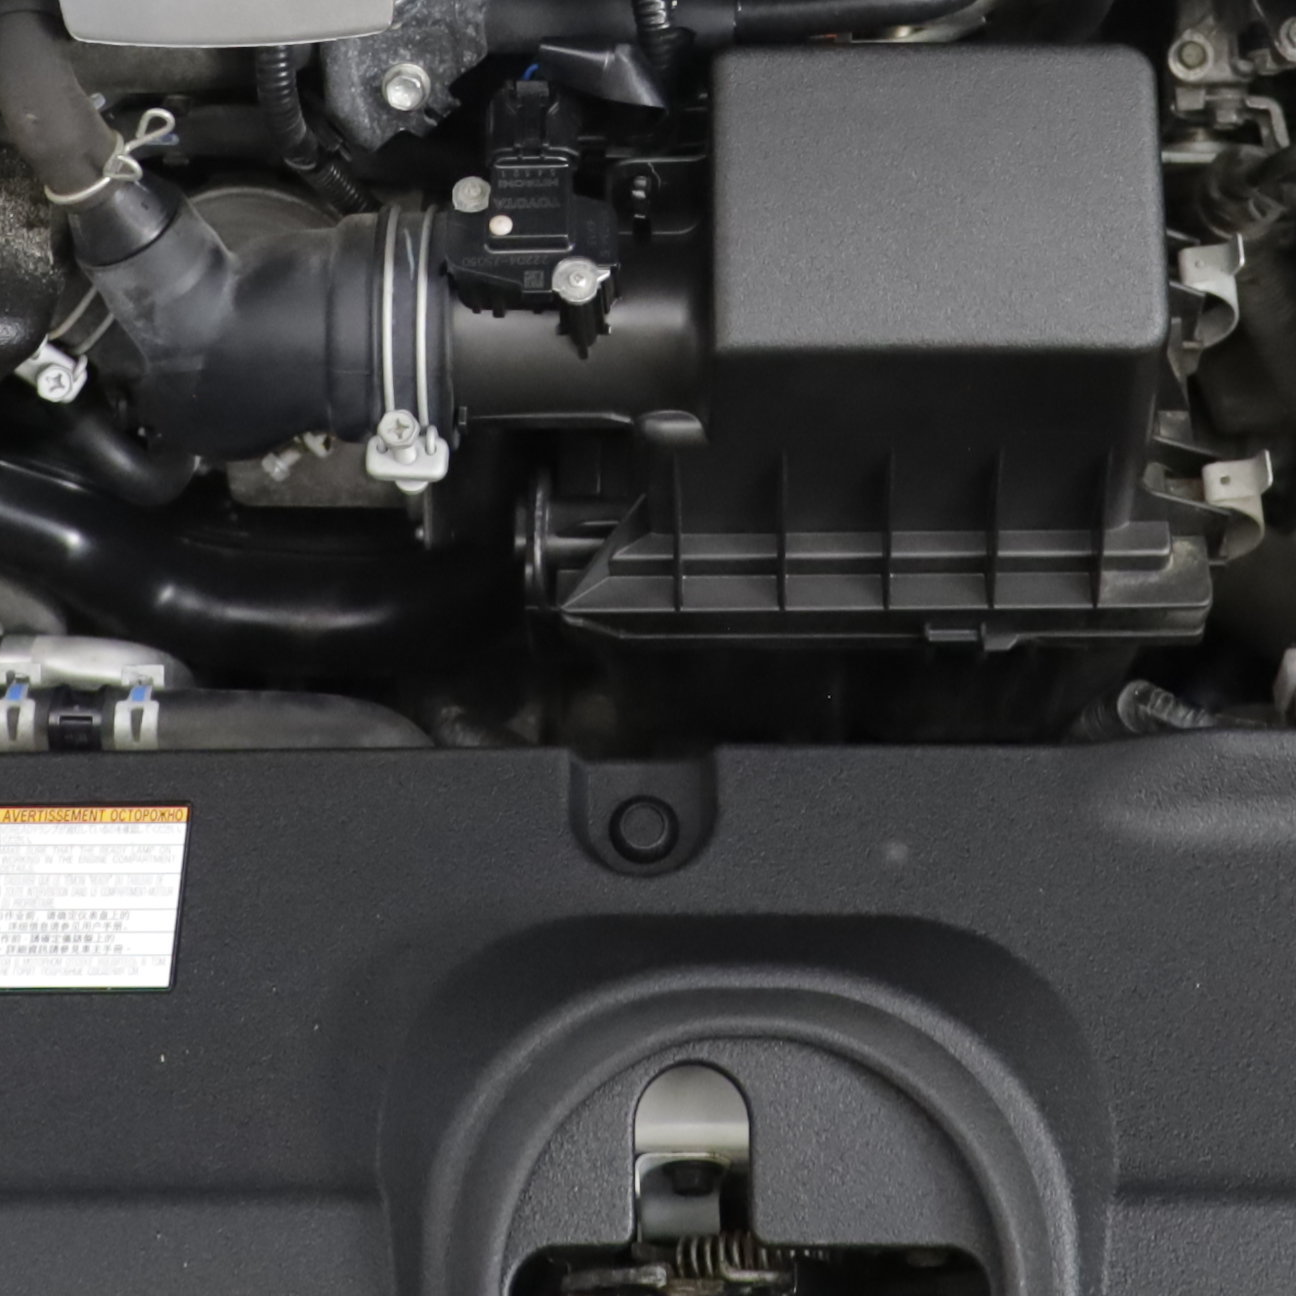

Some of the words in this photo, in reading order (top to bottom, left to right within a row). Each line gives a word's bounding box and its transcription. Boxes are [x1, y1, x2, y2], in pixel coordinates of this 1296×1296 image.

[493, 198, 560, 208] TOYOTA
[2, 809, 105, 823] AVERTISSEMENT
[110, 809, 184, 822] ОСТОРОЖНО
